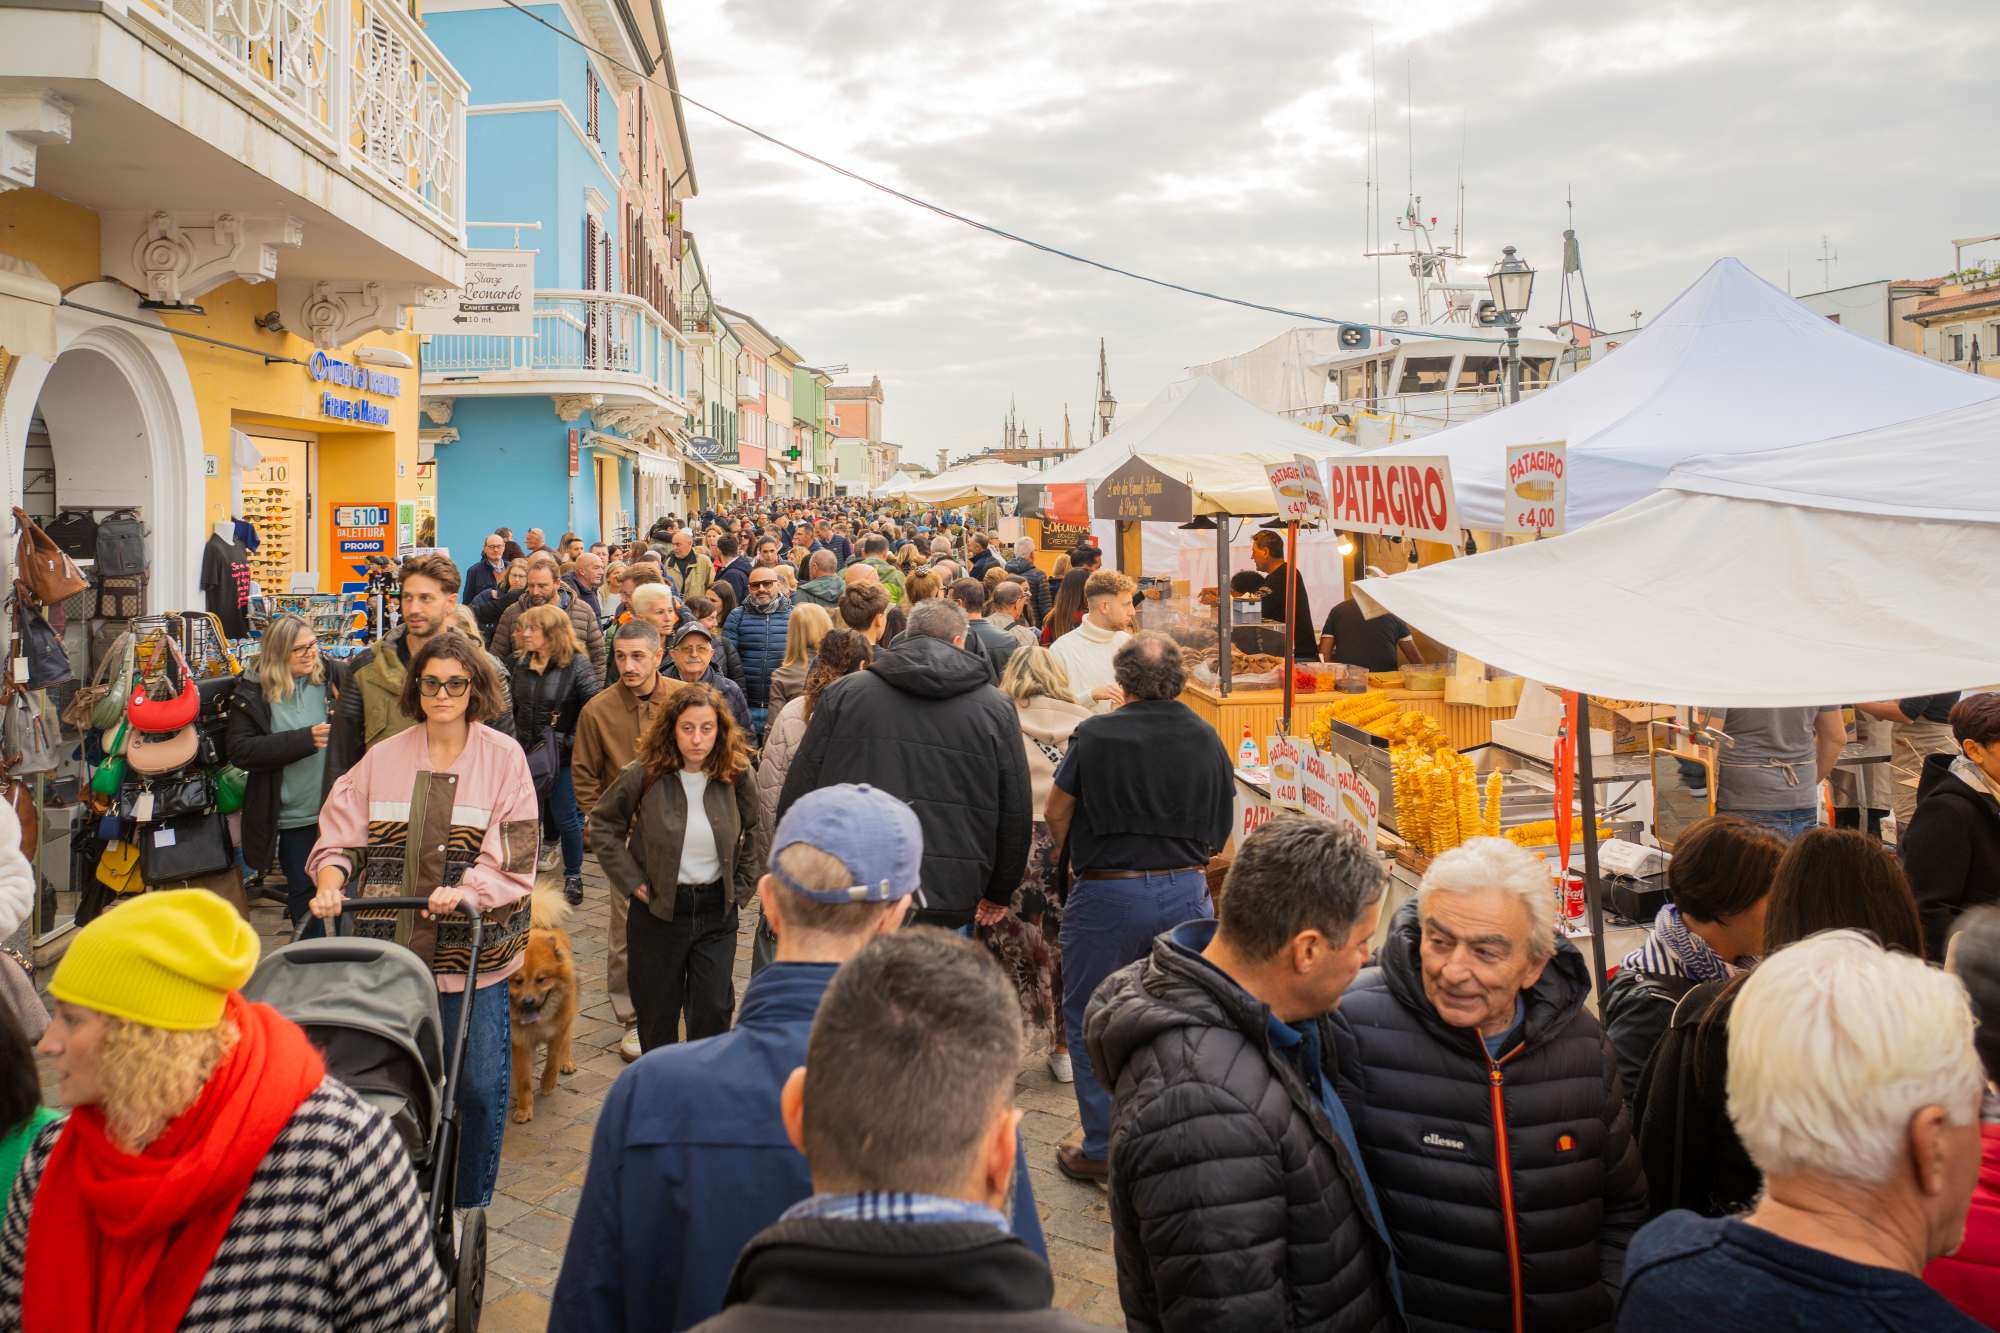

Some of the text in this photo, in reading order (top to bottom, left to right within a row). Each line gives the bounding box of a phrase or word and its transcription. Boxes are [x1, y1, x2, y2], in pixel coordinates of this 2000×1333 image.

[459, 282, 521, 301] Leonardo
[1271, 466, 1300, 488] PATAGIR
[1509, 450, 1563, 484] PATAGIRO
[1331, 465, 1447, 532] PATAGIRO
[346, 528, 385, 538] LETTURA
[344, 542, 380, 551] PROMO
[1269, 742, 1299, 766] PATAGIRO
[1338, 772, 1377, 818] PATAGIRO
[1423, 1133, 1464, 1149] ellesse
